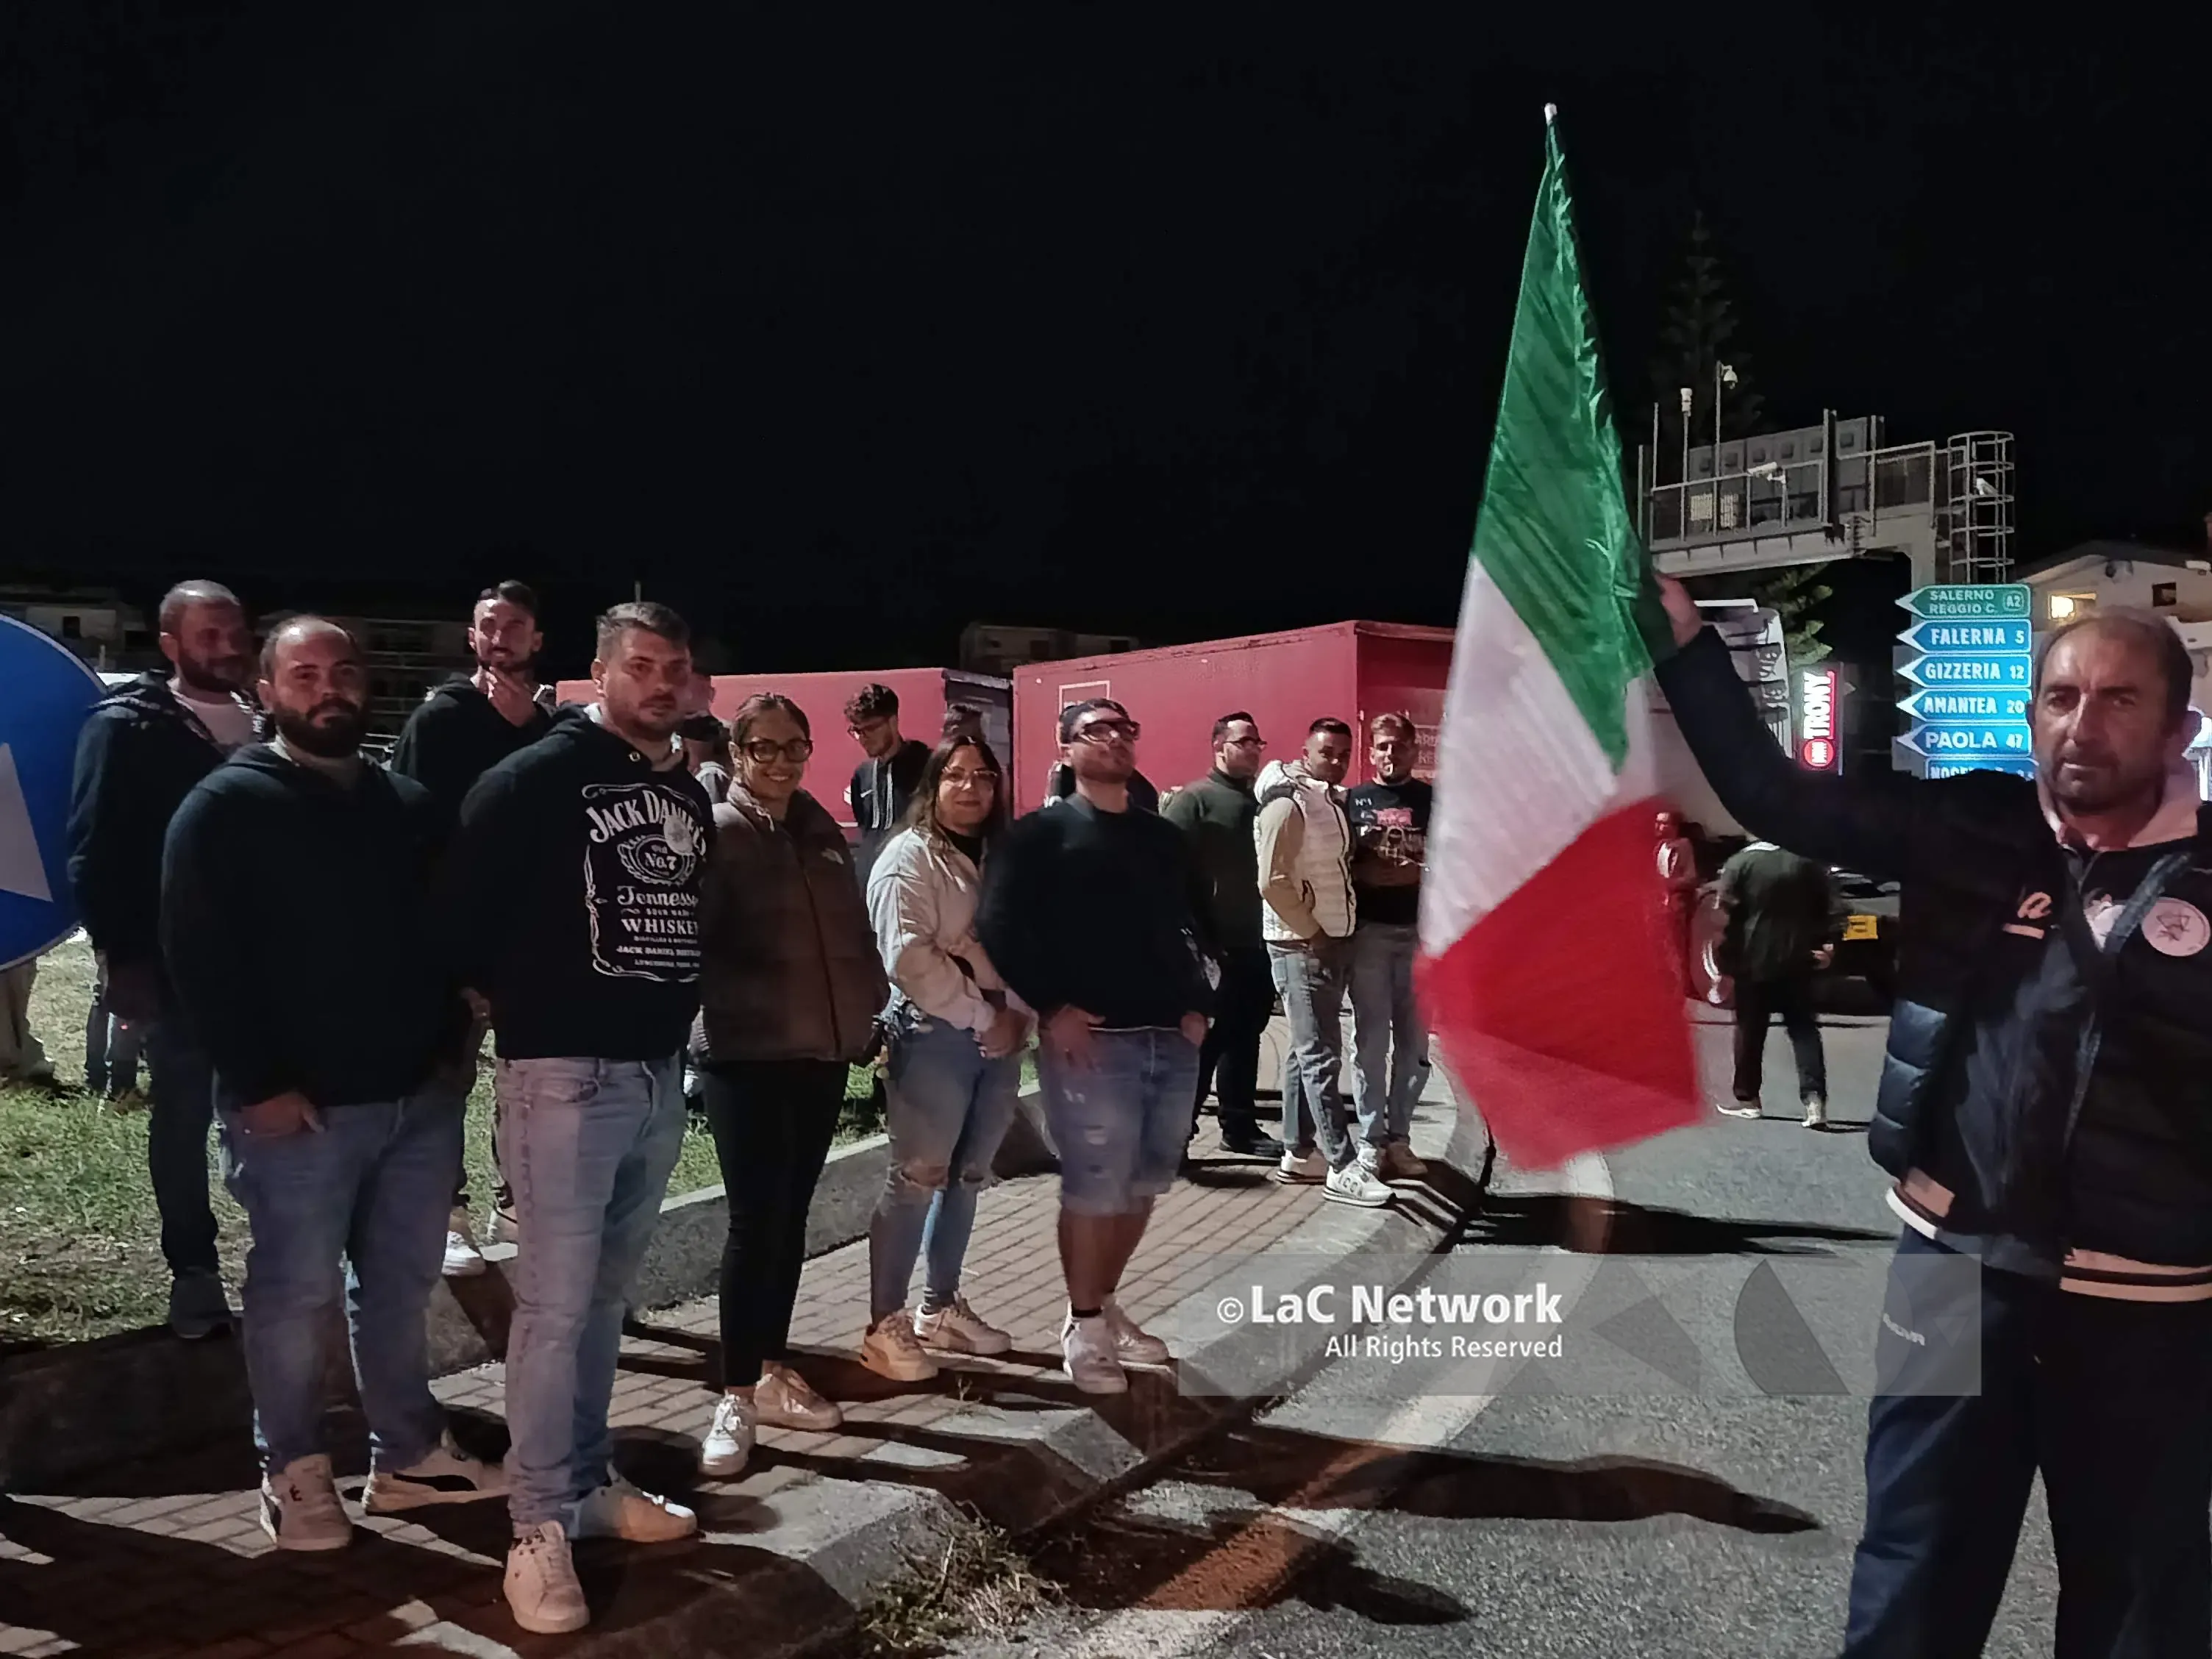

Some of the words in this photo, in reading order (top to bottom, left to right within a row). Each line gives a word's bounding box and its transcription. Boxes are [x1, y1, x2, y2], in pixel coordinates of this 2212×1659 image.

[1930, 589, 1994, 601] SALERNO
[2006, 595, 2021, 607] A2
[1929, 603, 1982, 615] REGGIO
[1930, 627, 2006, 645] FALERNA
[2015, 629, 2024, 644] 5
[1925, 663, 2001, 679] GIZZERIA
[2009, 666, 2024, 679] 12
[1803, 671, 1831, 740] TRONY
[1923, 696, 1998, 713] AMANTEA
[2006, 699, 2025, 714] 20
[1924, 731, 1998, 749] PAOLA
[585, 799, 647, 843] JACK
